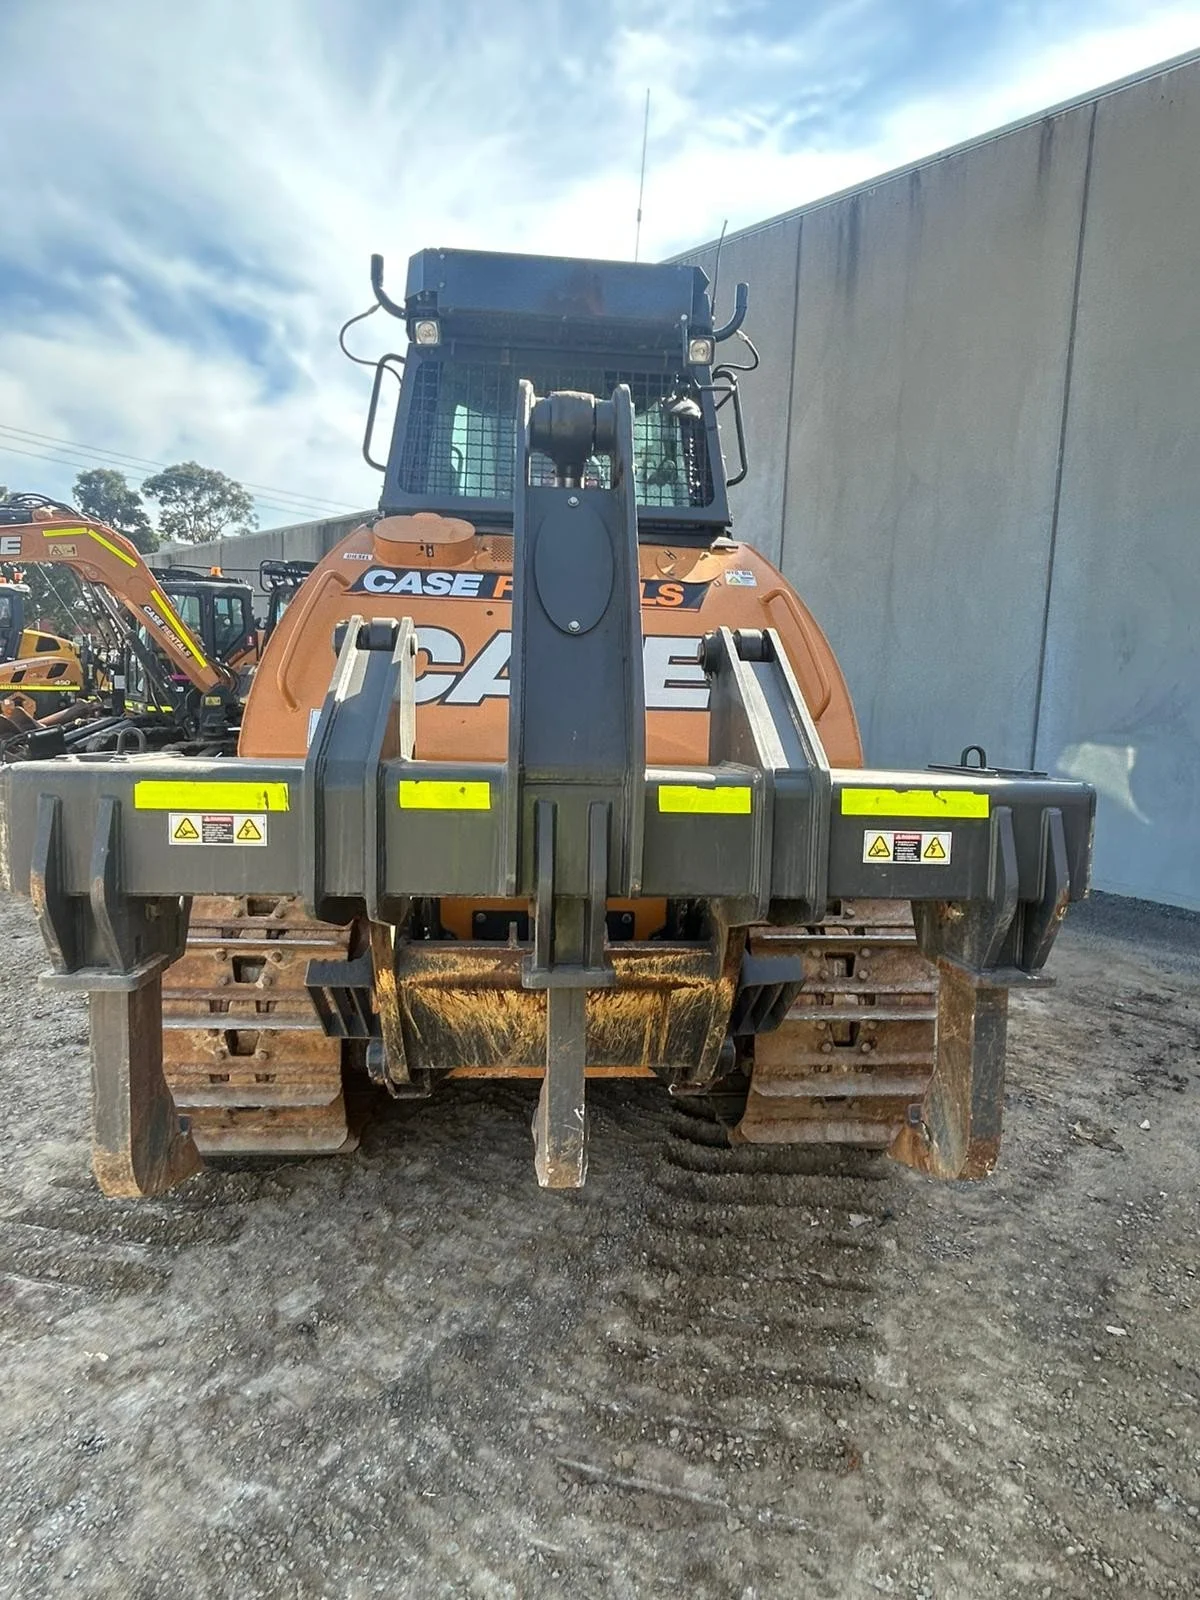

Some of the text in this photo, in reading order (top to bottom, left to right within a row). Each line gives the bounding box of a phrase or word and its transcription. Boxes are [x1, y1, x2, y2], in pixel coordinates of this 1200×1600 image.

[363, 569, 485, 597] CASE
[143, 605, 191, 657] CASE RENTALS
[416, 625, 711, 709] CAE
